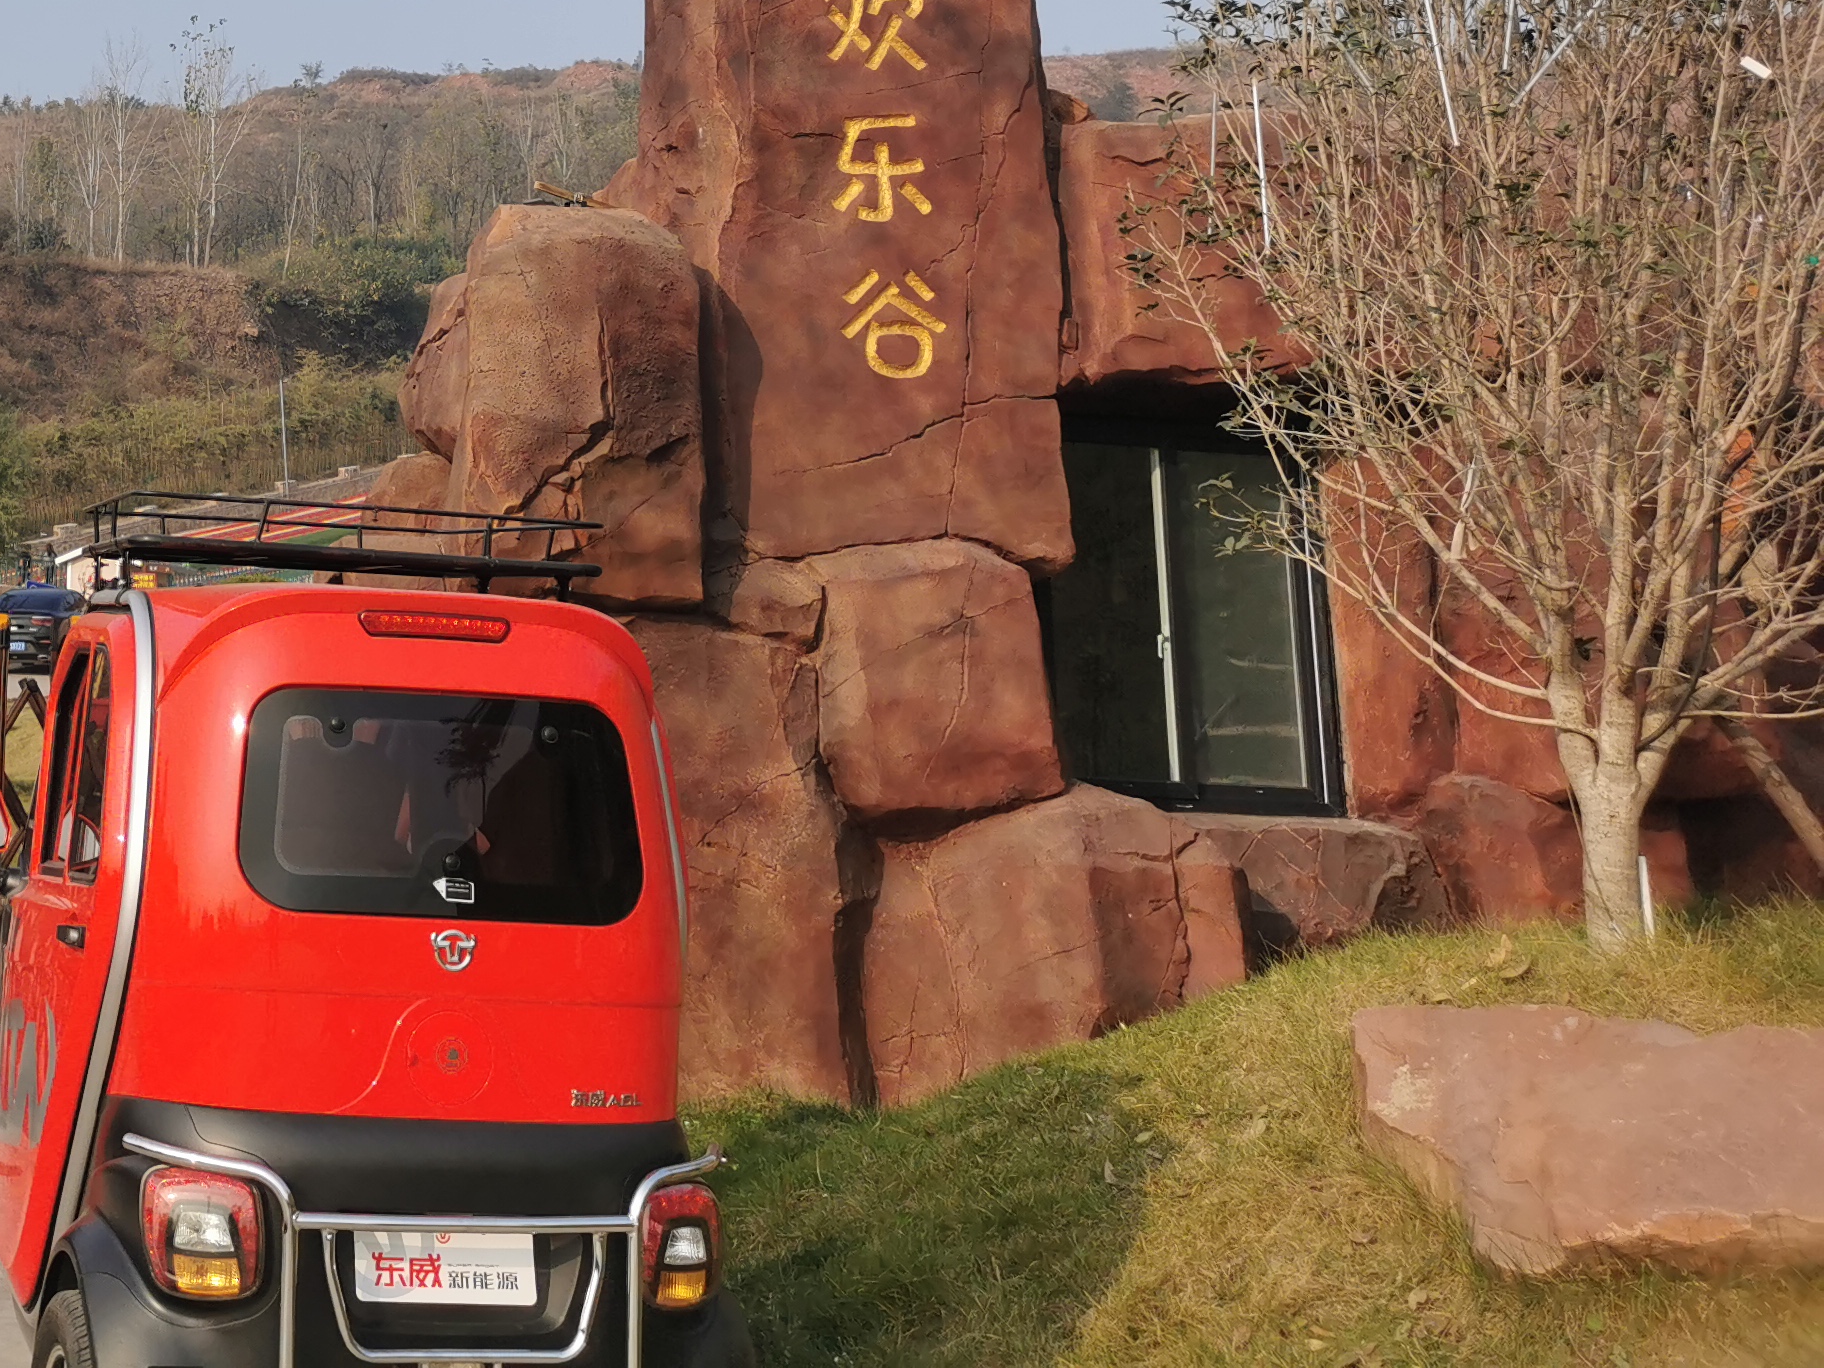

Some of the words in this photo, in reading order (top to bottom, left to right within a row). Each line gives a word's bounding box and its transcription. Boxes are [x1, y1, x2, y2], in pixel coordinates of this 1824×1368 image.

[371, 1251, 444, 1288] 东威
[447, 1270, 520, 1291] 新能源
